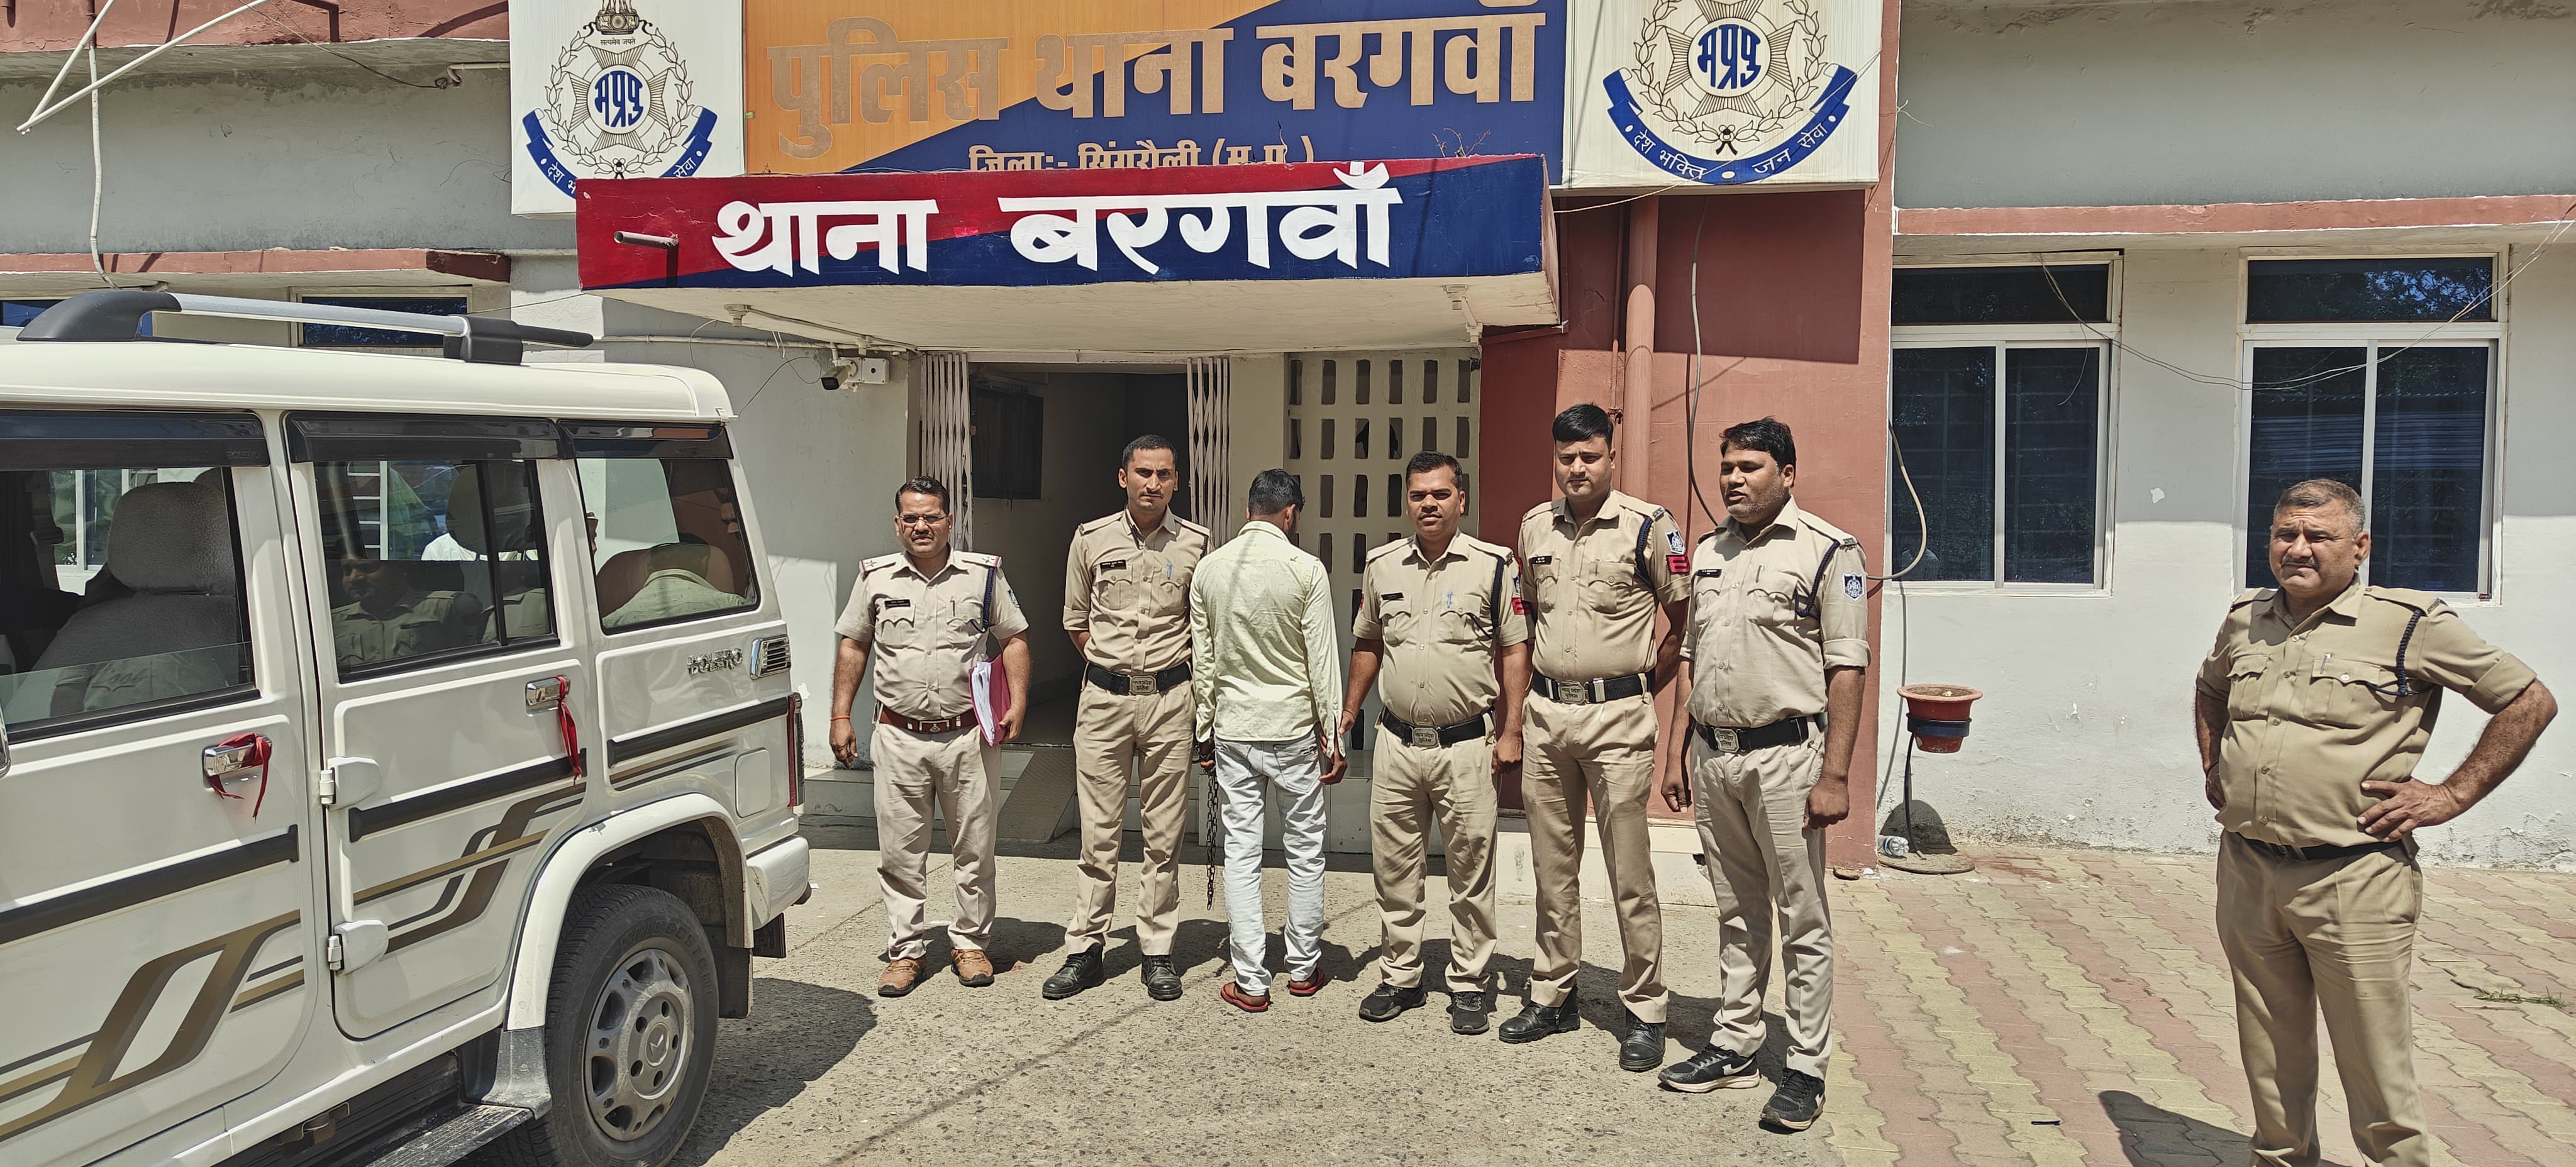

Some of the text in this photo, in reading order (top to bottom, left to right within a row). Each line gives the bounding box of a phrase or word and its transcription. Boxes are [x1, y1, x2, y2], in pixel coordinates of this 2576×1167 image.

[600, 36, 636, 45] सत्यमेव जयते
[767, 0, 1546, 159] पुलिस थाना बरगवा
[548, 162, 565, 184] देश
[1635, 123, 1828, 179] देश भक्ति जन सेवा
[712, 161, 1403, 277] थाना बरगवाँ
